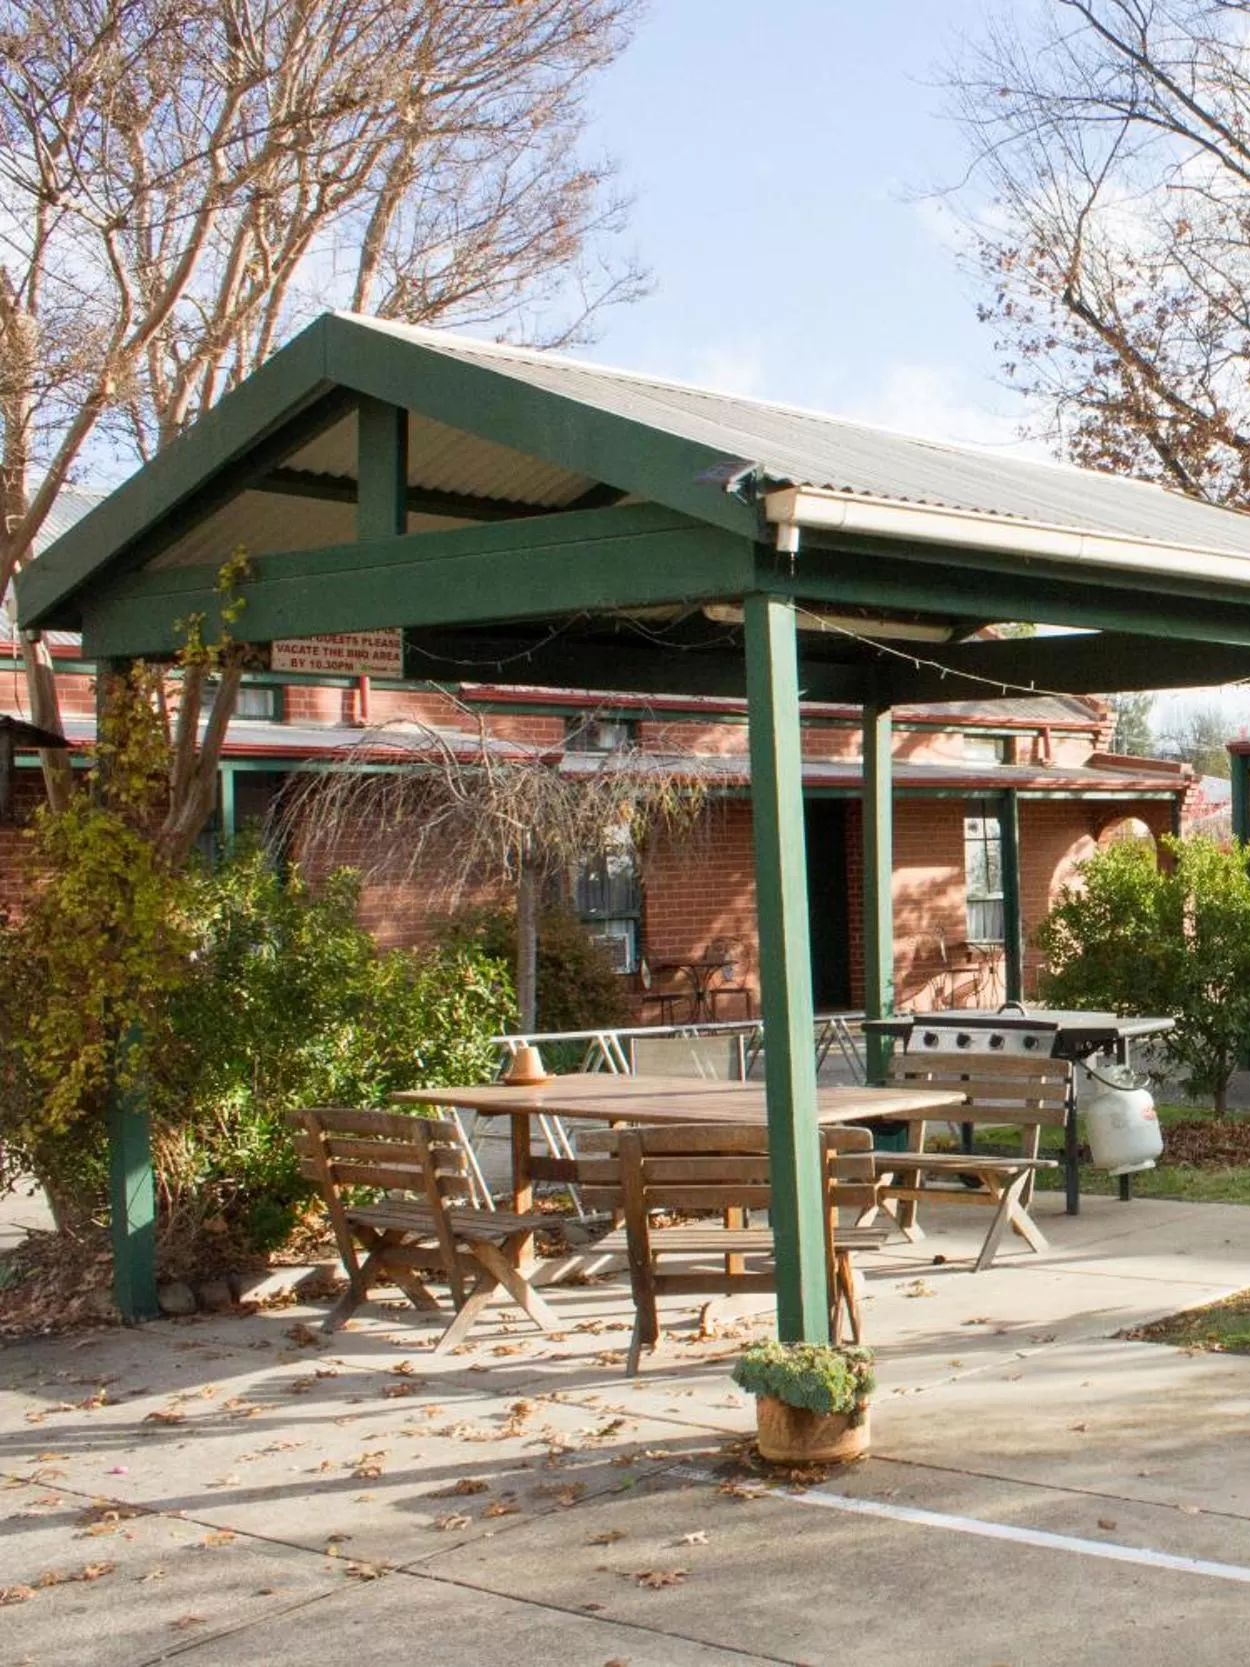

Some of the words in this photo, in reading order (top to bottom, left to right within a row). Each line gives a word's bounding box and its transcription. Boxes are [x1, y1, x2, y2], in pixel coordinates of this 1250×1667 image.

[361, 637, 401, 648] PLEASE
[276, 644, 320, 656] VACATE
[323, 647, 344, 658] THE
[372, 650, 401, 661] AREA
[290, 658, 306, 668] BY
[309, 660, 354, 671] 10.30PM
